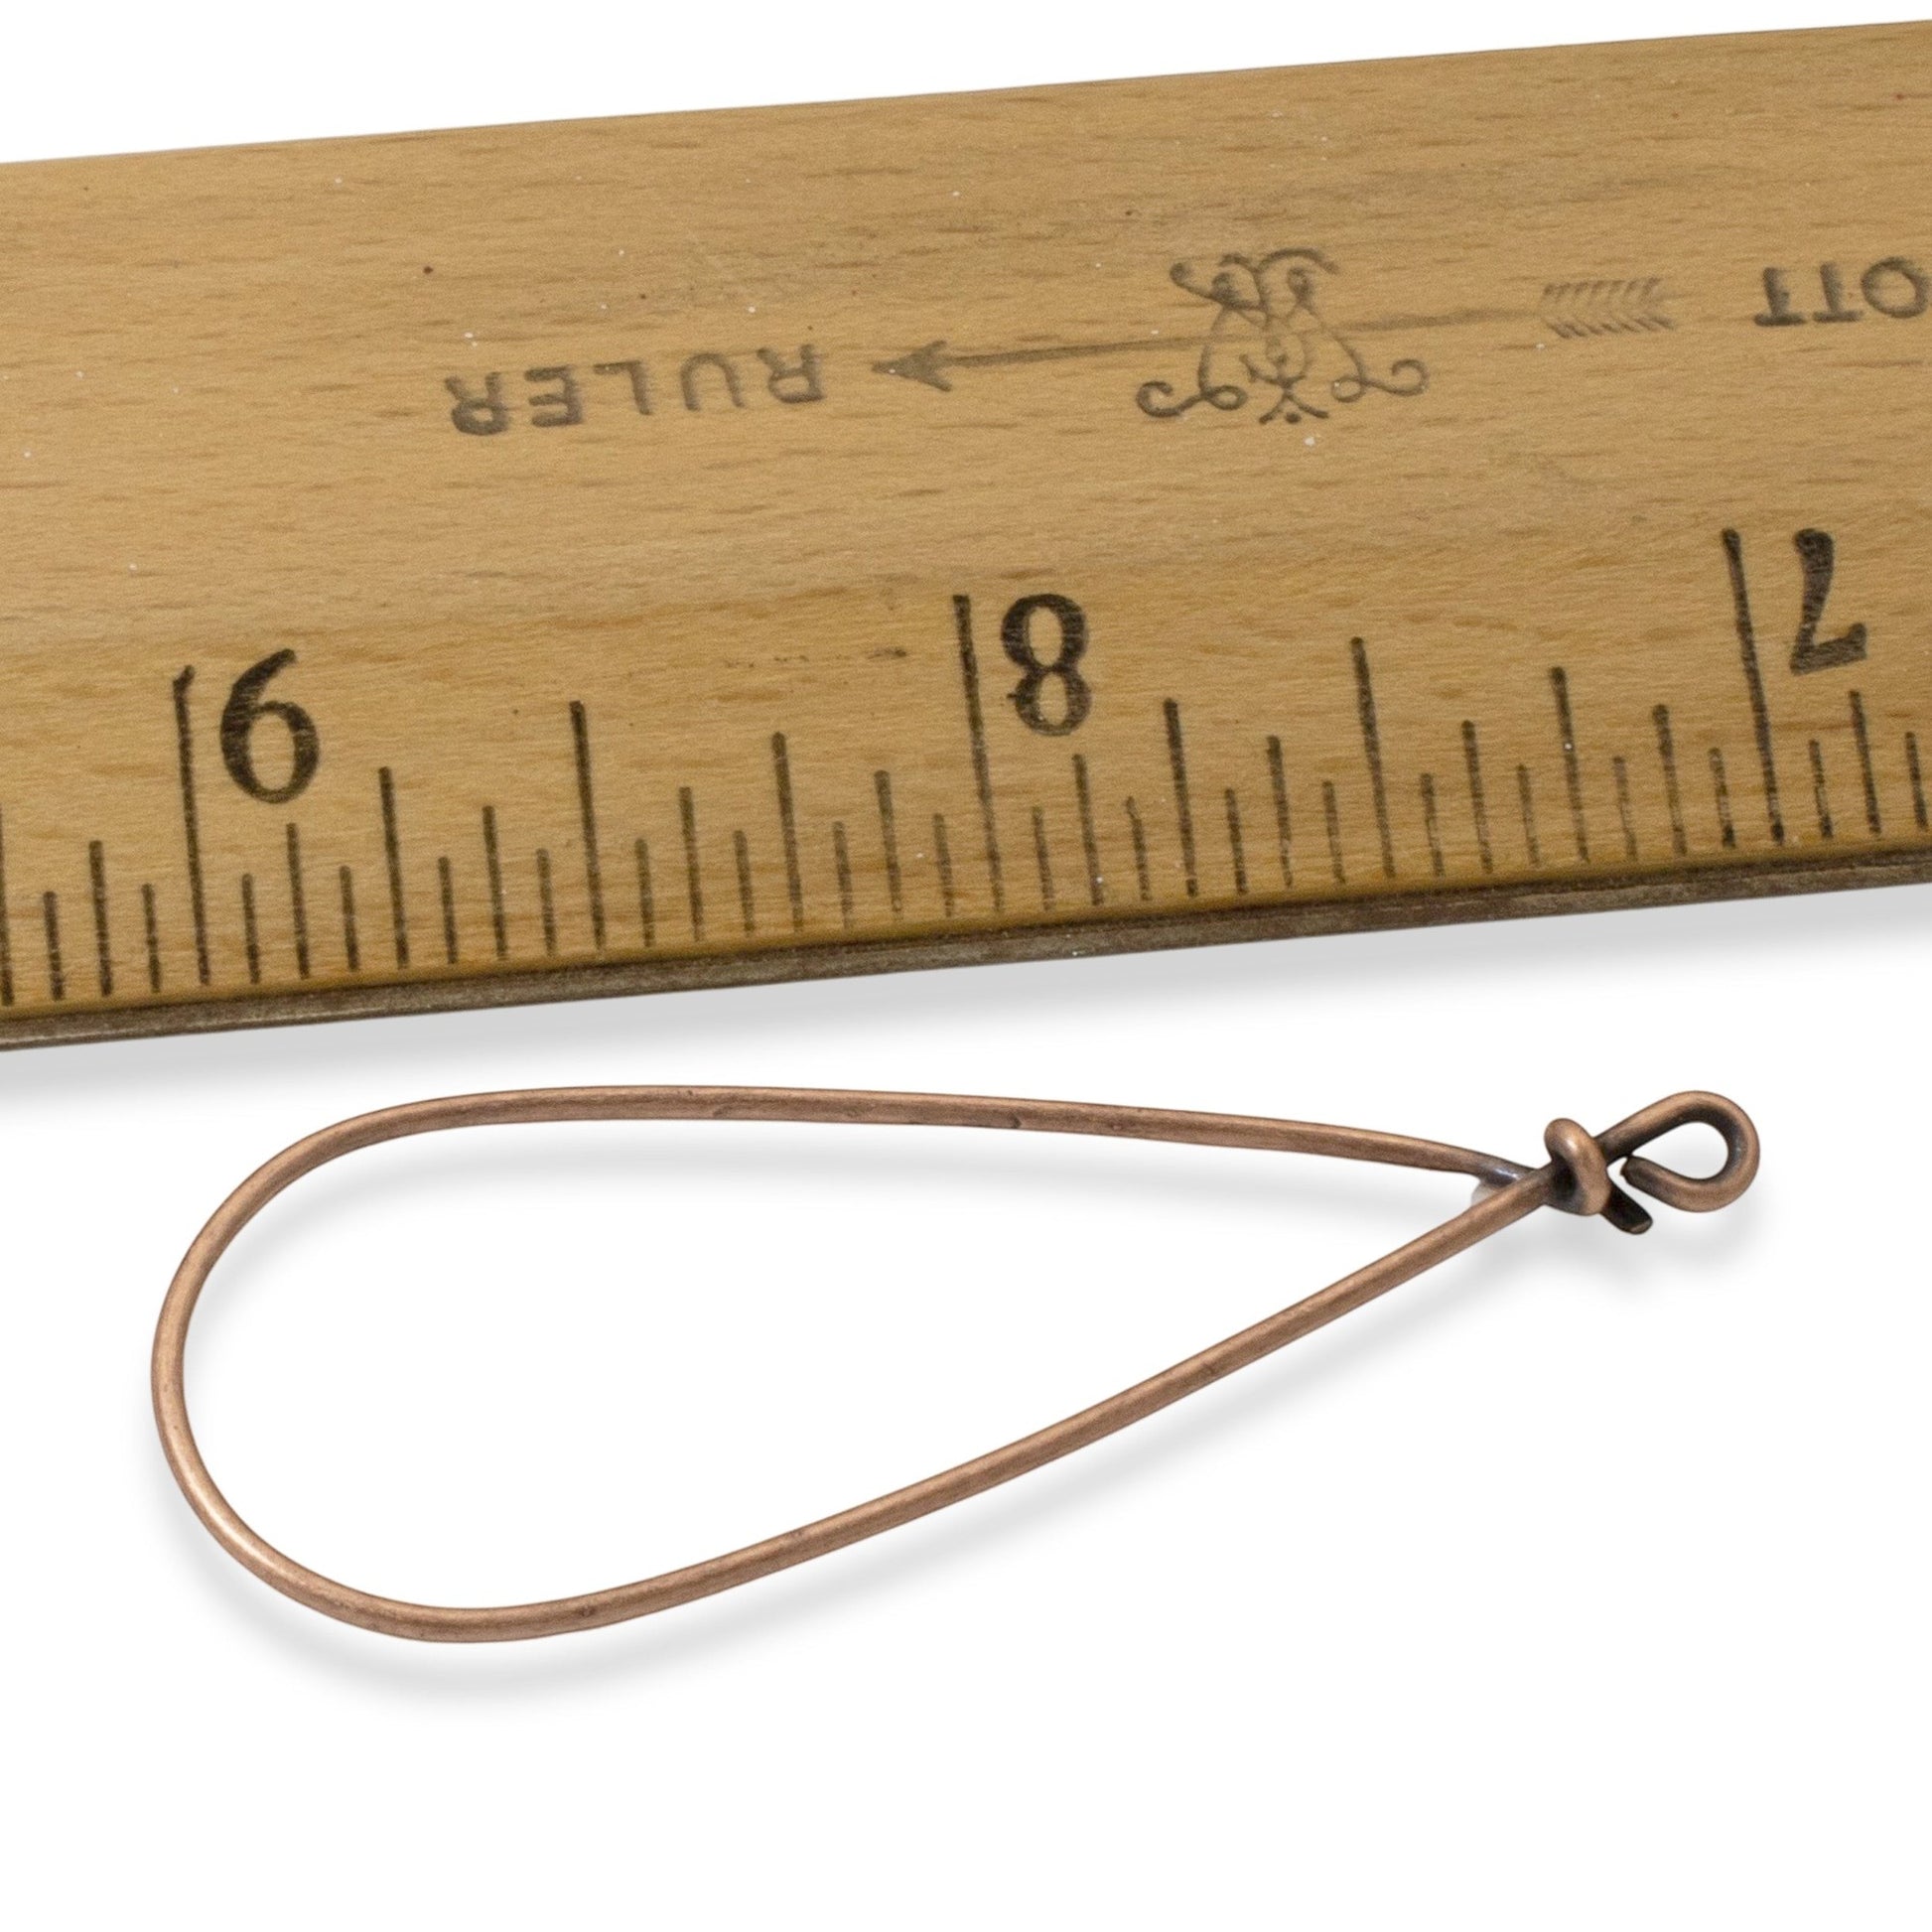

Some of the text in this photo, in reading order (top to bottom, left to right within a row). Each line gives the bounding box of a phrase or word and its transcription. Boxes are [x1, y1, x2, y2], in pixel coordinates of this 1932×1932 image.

[444, 256, 1931, 437] OTT RULER
[1000, 593, 1092, 737] 8
[1789, 528, 1867, 676] 7
